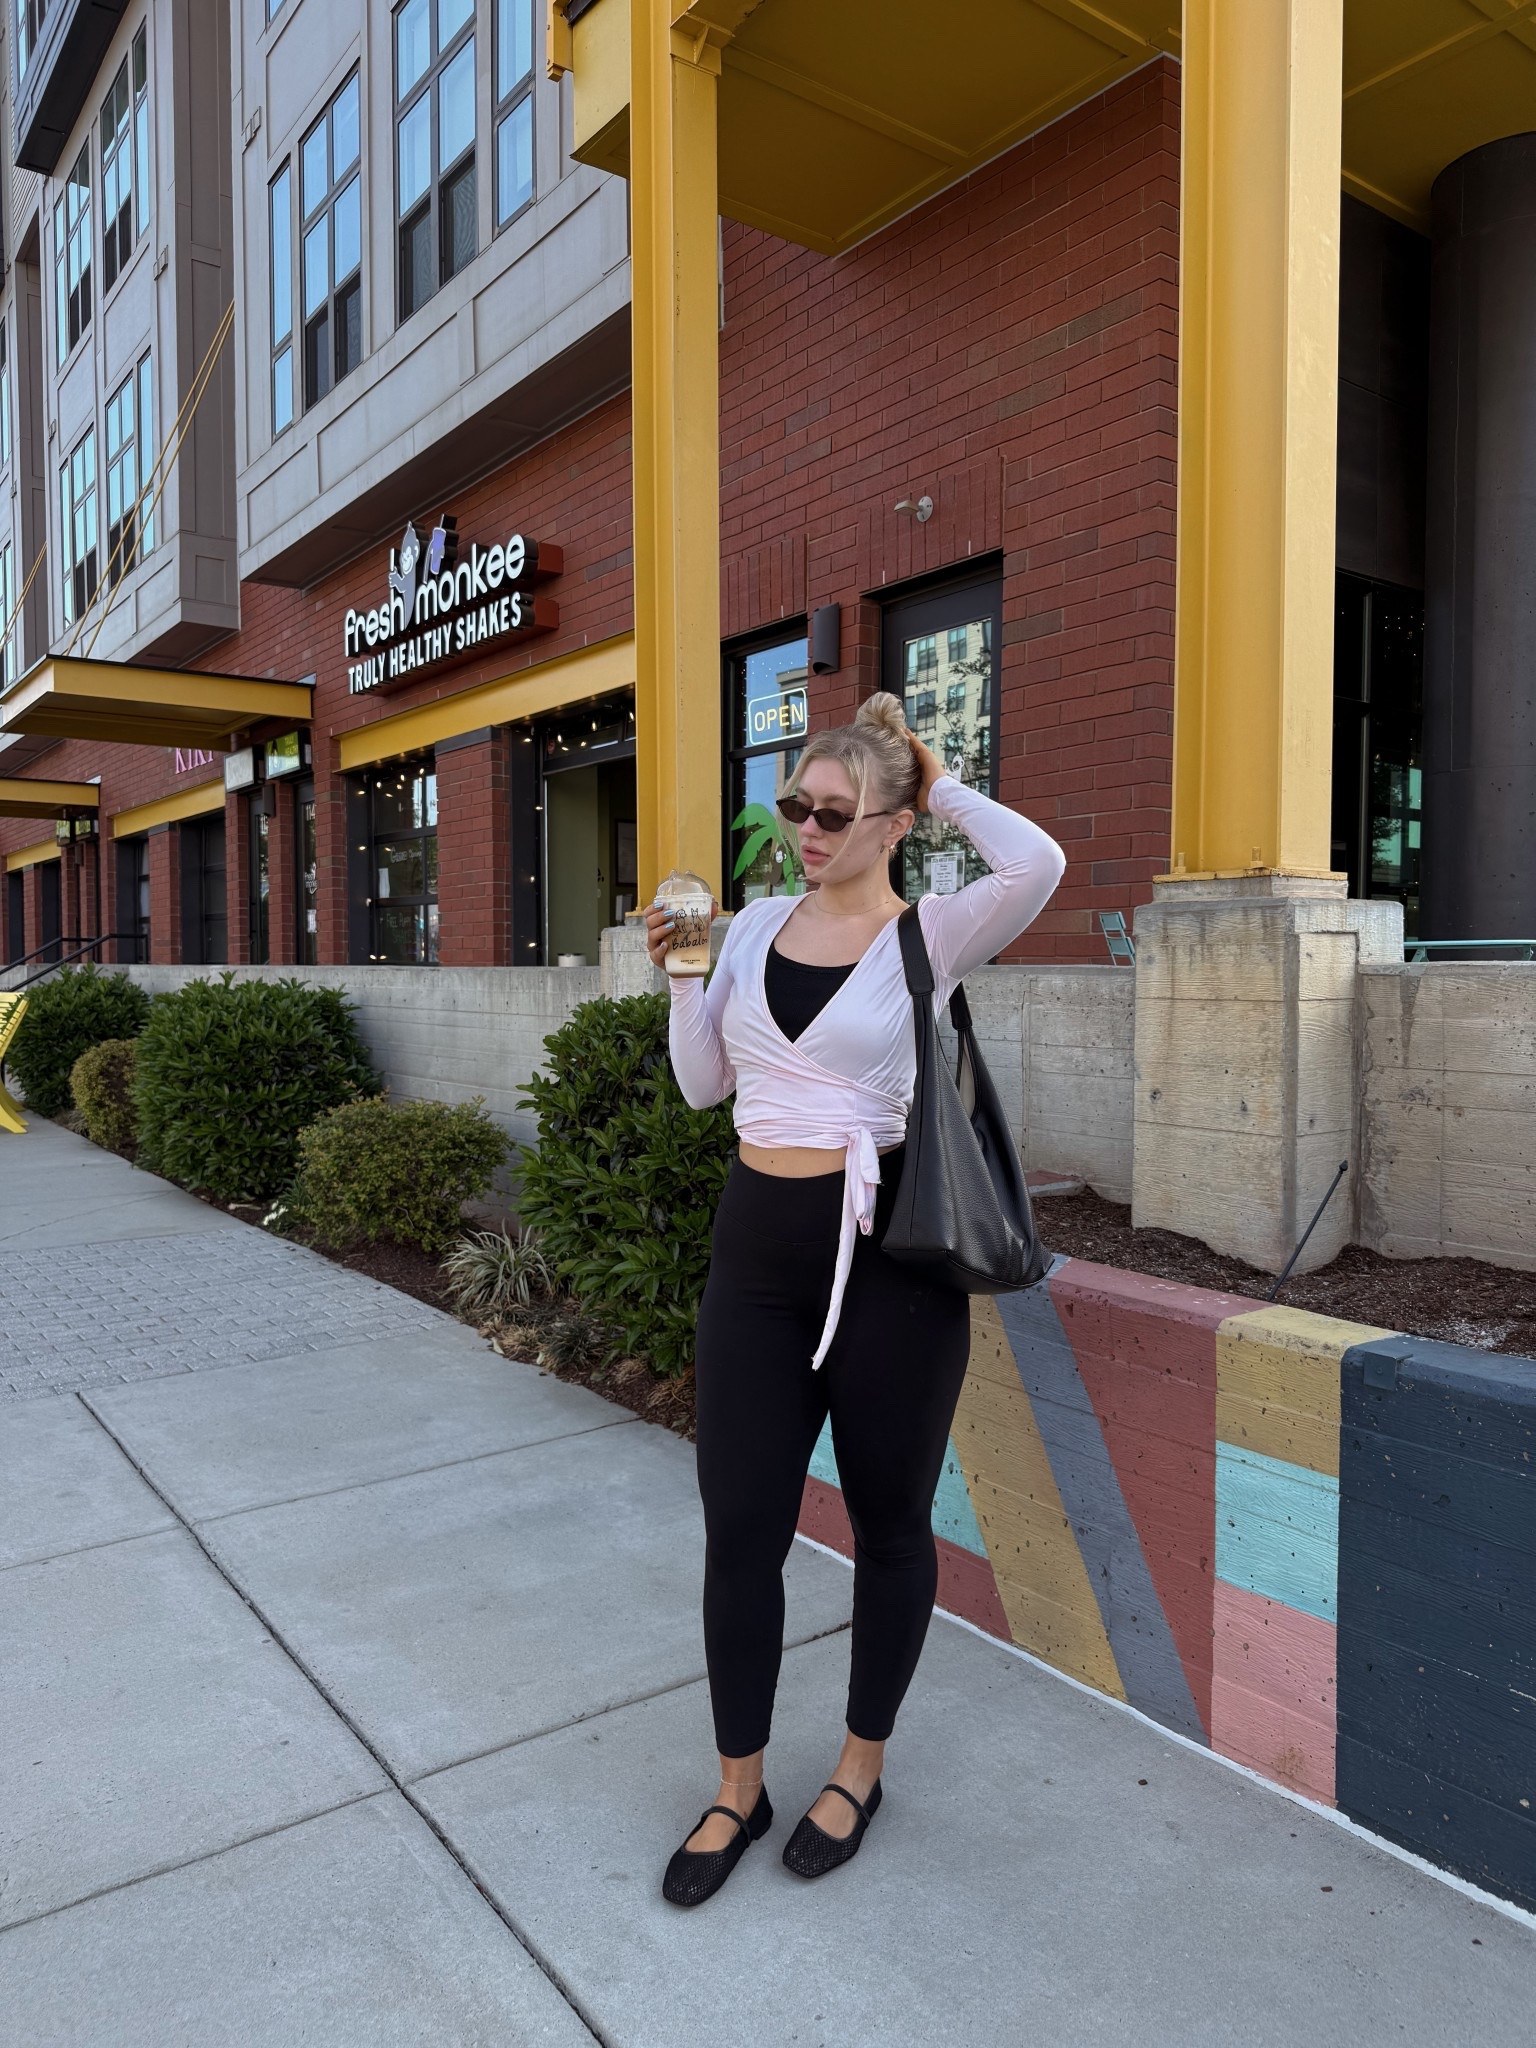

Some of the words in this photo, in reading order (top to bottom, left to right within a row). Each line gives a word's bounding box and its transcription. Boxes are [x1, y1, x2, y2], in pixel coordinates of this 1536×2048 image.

[344, 548, 405, 657] fresh
[415, 534, 525, 625] monkee
[348, 652, 386, 695] TRULY
[389, 622, 452, 678] HEALTHY
[455, 591, 522, 650] SHAKES
[754, 702, 804, 732] OPEN
